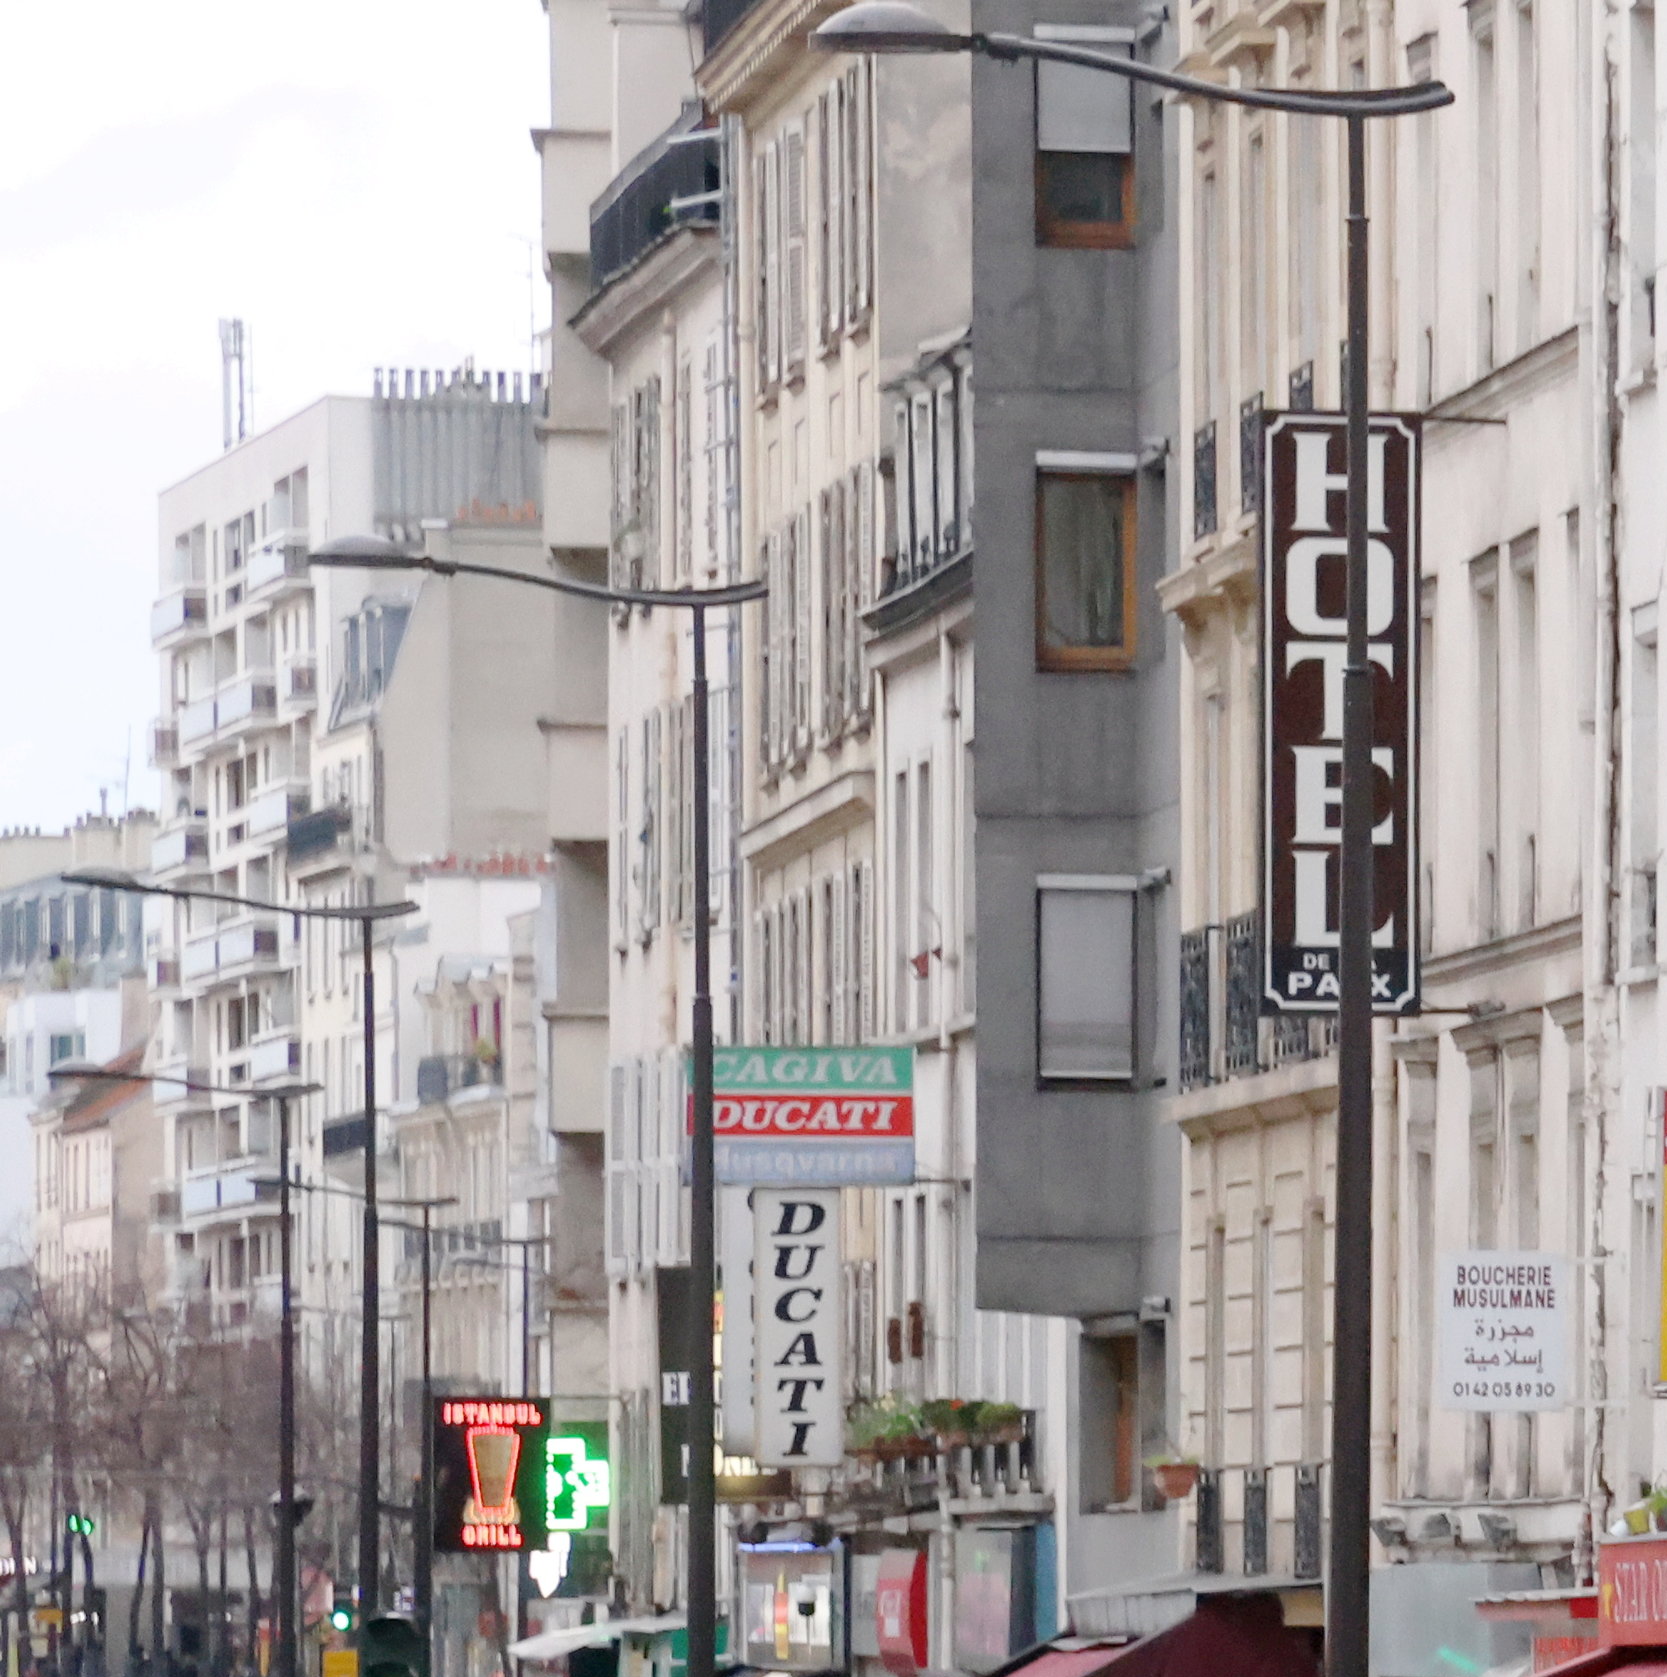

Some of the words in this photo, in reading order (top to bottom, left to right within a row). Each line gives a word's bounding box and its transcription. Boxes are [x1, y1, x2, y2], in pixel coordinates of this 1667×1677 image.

[1284, 431, 1394, 949] HOTEL
[1303, 954, 1330, 971] DE
[1287, 973, 1392, 997] PAX
[713, 1053, 898, 1085] CAGIVA
[713, 1100, 898, 1131] DUCATI
[1457, 1265, 1552, 1286] BOUCHERIE
[1453, 1288, 1556, 1309] MUSULMANE
[771, 1201, 826, 1457] DUCATI
[1474, 1318, 1535, 1344] مجزرة
[1464, 1347, 1543, 1374] إسلامية
[1453, 1382, 1470, 1397] 01
[1473, 1382, 1489, 1397] 42
[1535, 1382, 1556, 1398] 30
[1614, 1561, 1648, 1623] STAR
